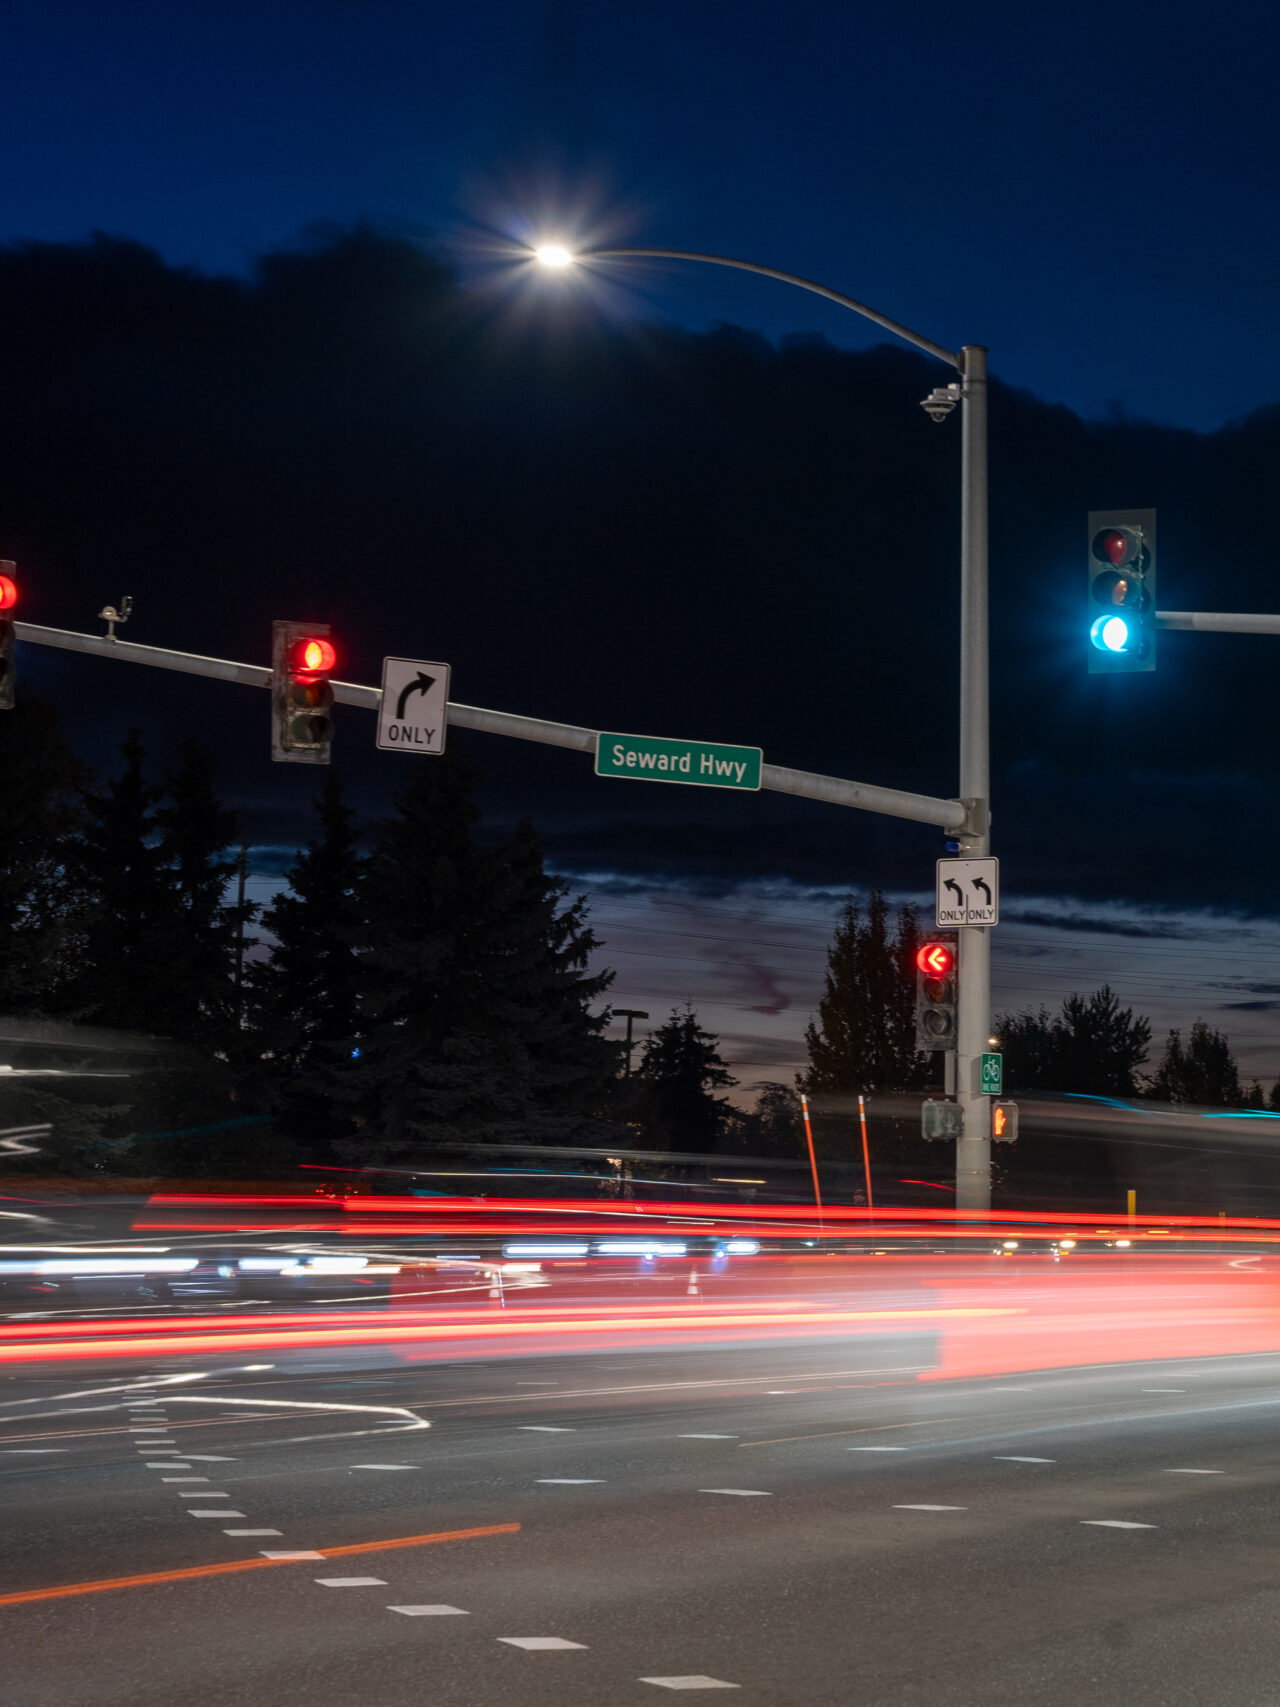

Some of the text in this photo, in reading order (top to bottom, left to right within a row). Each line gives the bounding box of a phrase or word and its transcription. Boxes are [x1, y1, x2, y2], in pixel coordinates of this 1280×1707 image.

[388, 724, 436, 745] ONLY
[612, 744, 747, 783] Seward Hwy
[940, 909, 994, 921] ONLY ONLY
